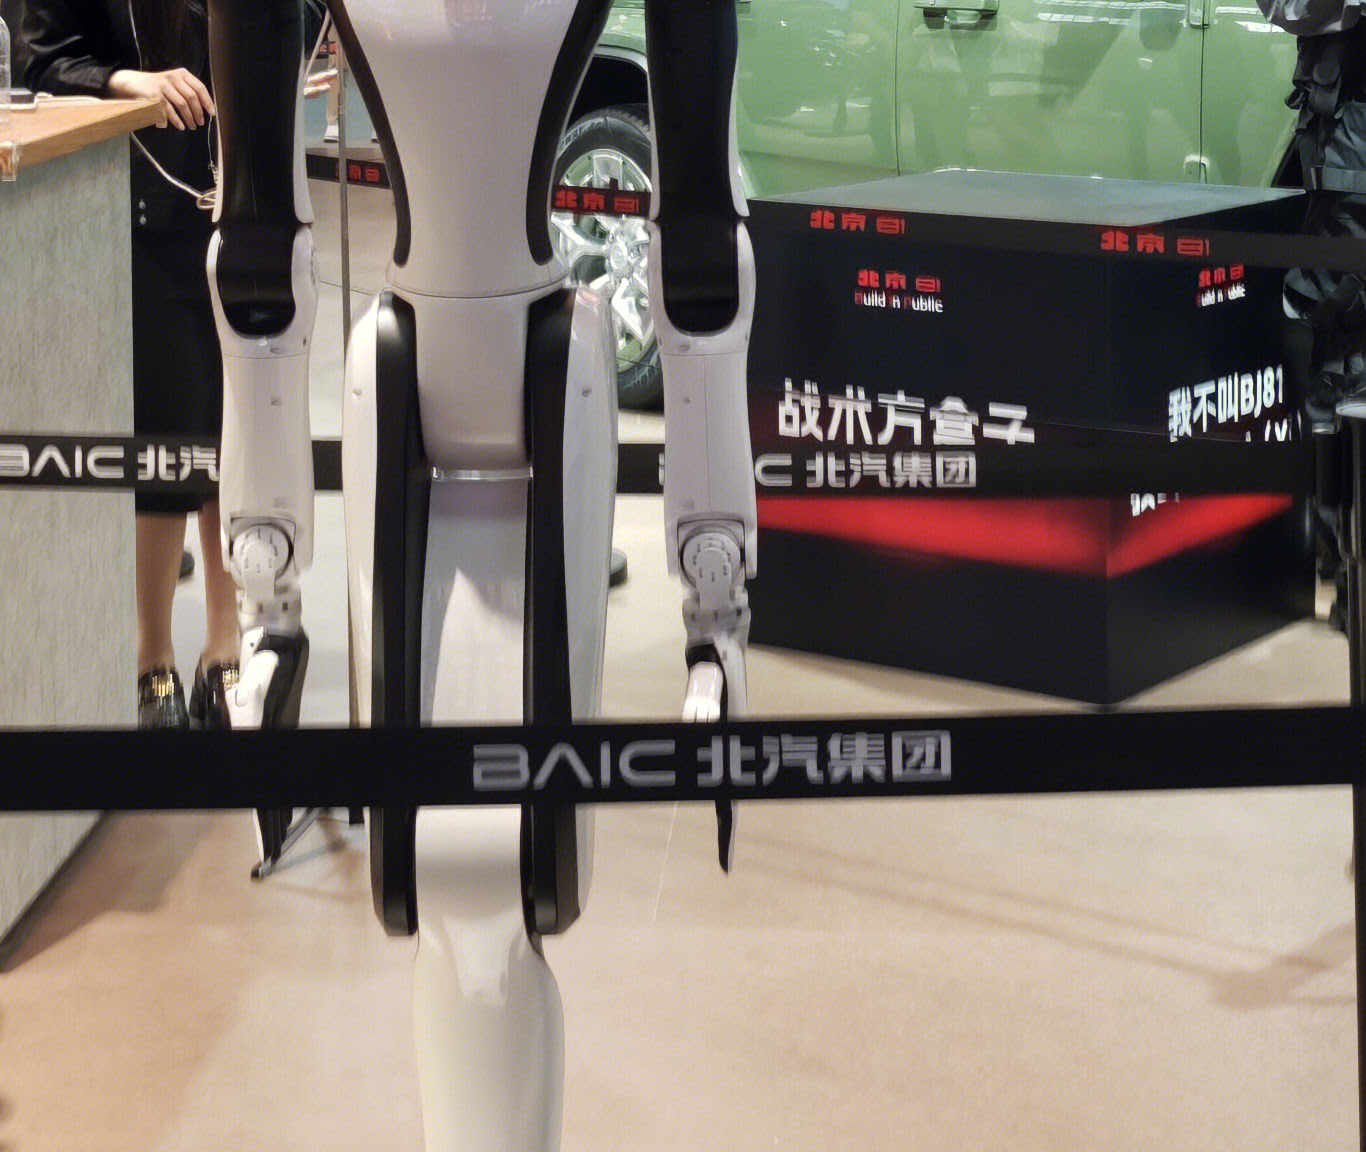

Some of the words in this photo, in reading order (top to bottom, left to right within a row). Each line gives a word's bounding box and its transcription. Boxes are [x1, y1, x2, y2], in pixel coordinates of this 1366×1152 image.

[137, 444, 220, 482] 北汽
[806, 451, 977, 488] 北汽集团
[473, 738, 677, 792] BAIC
[697, 729, 952, 787] 北汽集团
